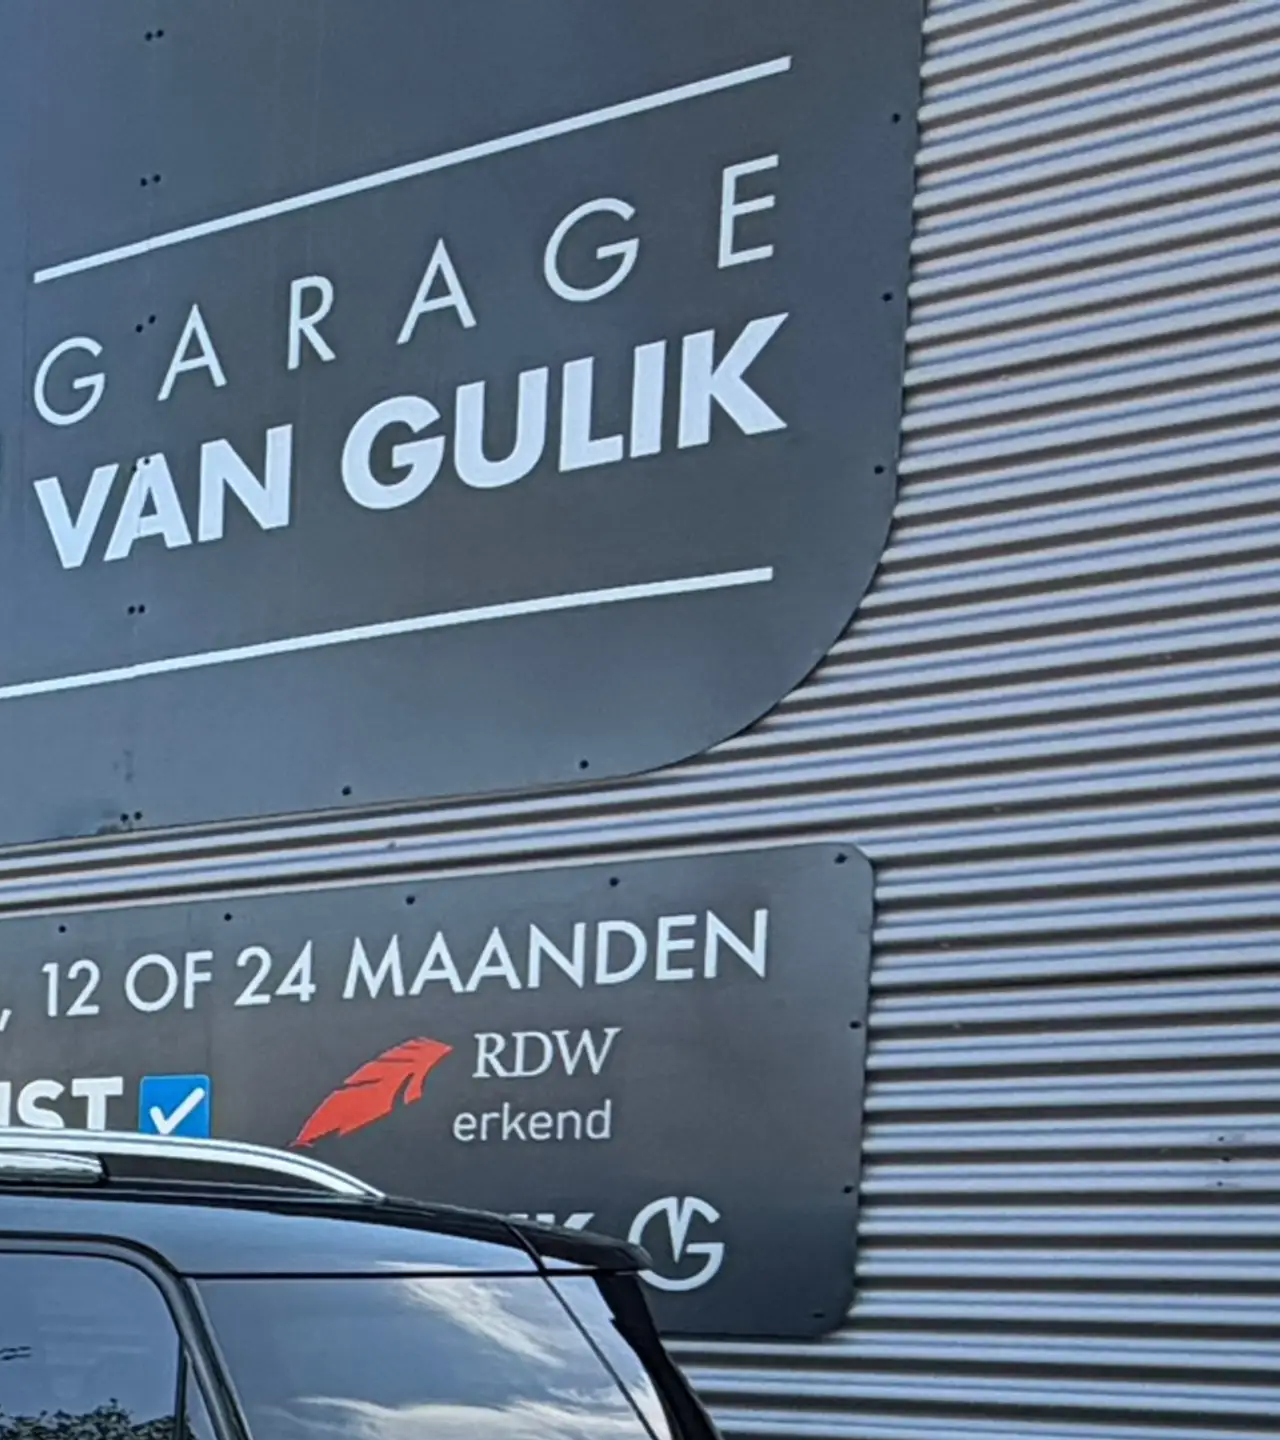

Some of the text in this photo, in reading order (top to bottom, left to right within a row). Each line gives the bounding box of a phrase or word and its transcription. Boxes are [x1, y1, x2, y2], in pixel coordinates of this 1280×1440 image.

[33, 153, 779, 426] GARAGE
[33, 312, 790, 569] VAN GULIK
[40, 958, 101, 1018] 12
[123, 949, 215, 1013] OF
[234, 938, 318, 1007] 24
[341, 908, 769, 1000] MAANDEN
[471, 1026, 623, 1079] RDW
[452, 1099, 613, 1142] erkend
